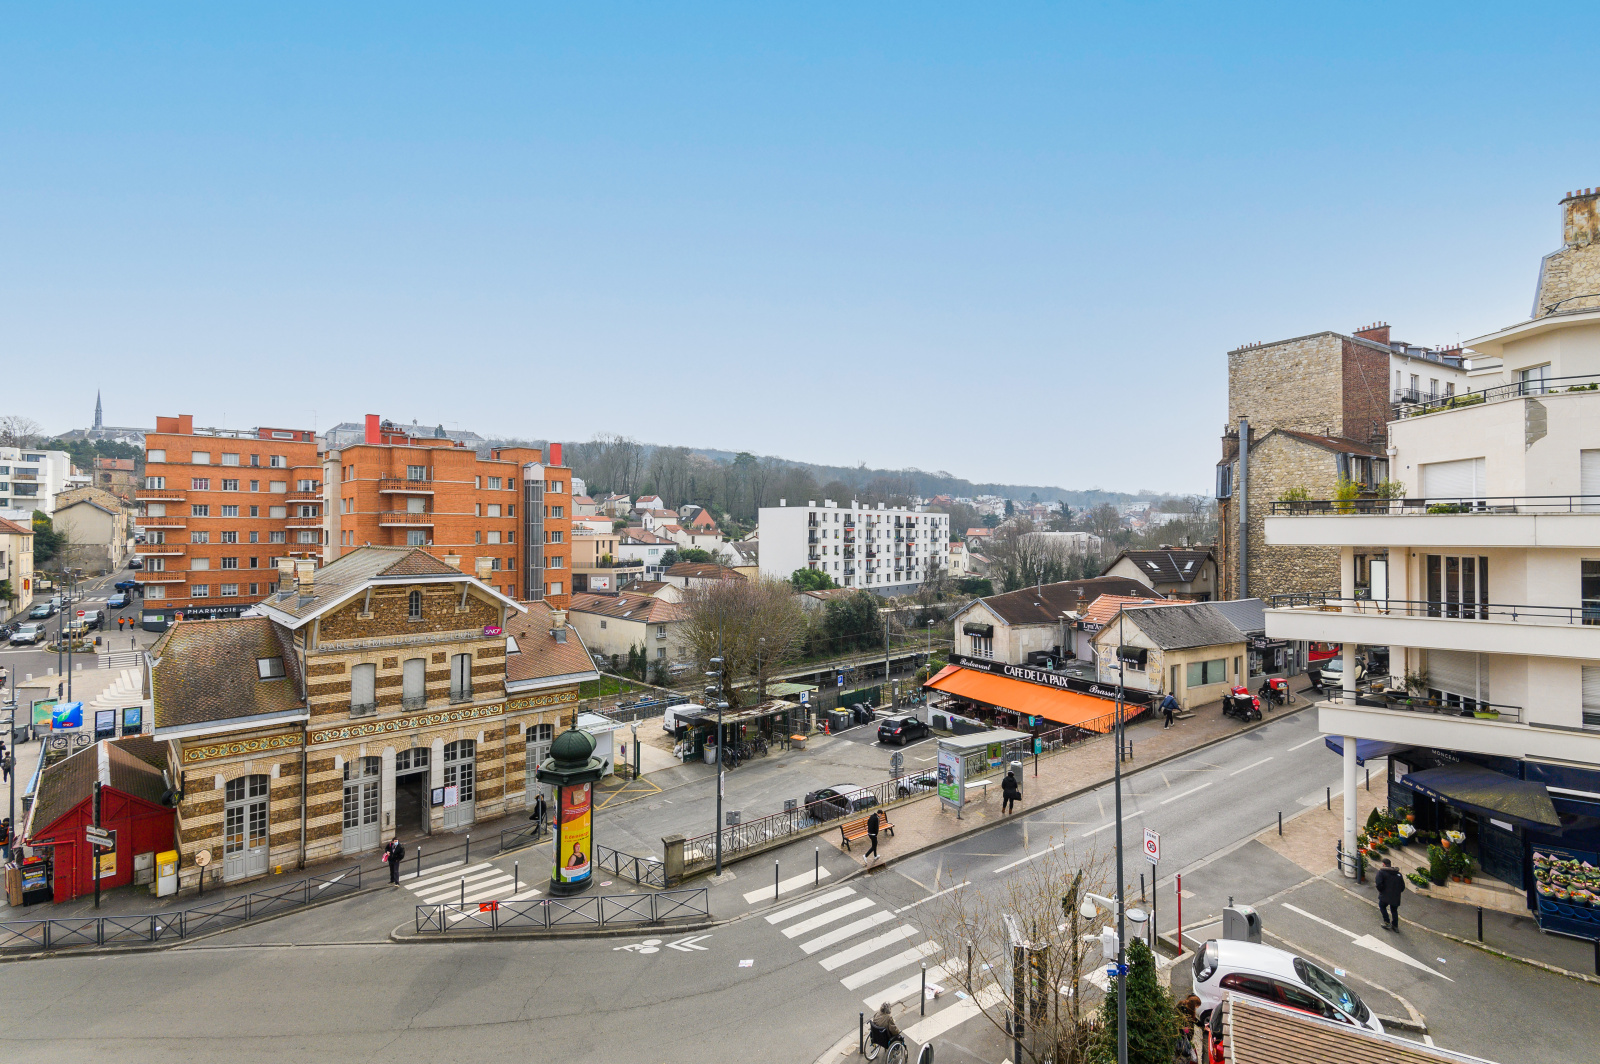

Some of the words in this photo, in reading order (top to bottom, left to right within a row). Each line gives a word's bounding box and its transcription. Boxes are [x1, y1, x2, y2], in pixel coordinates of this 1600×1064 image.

[960, 658, 992, 671] Restaurant
[1004, 665, 1024, 678] CAFE
[1024, 669, 1036, 681] DE
[1037, 672, 1048, 683] LA
[1049, 674, 1069, 688] PAIX
[1432, 749, 1459, 762] MONCEAU
